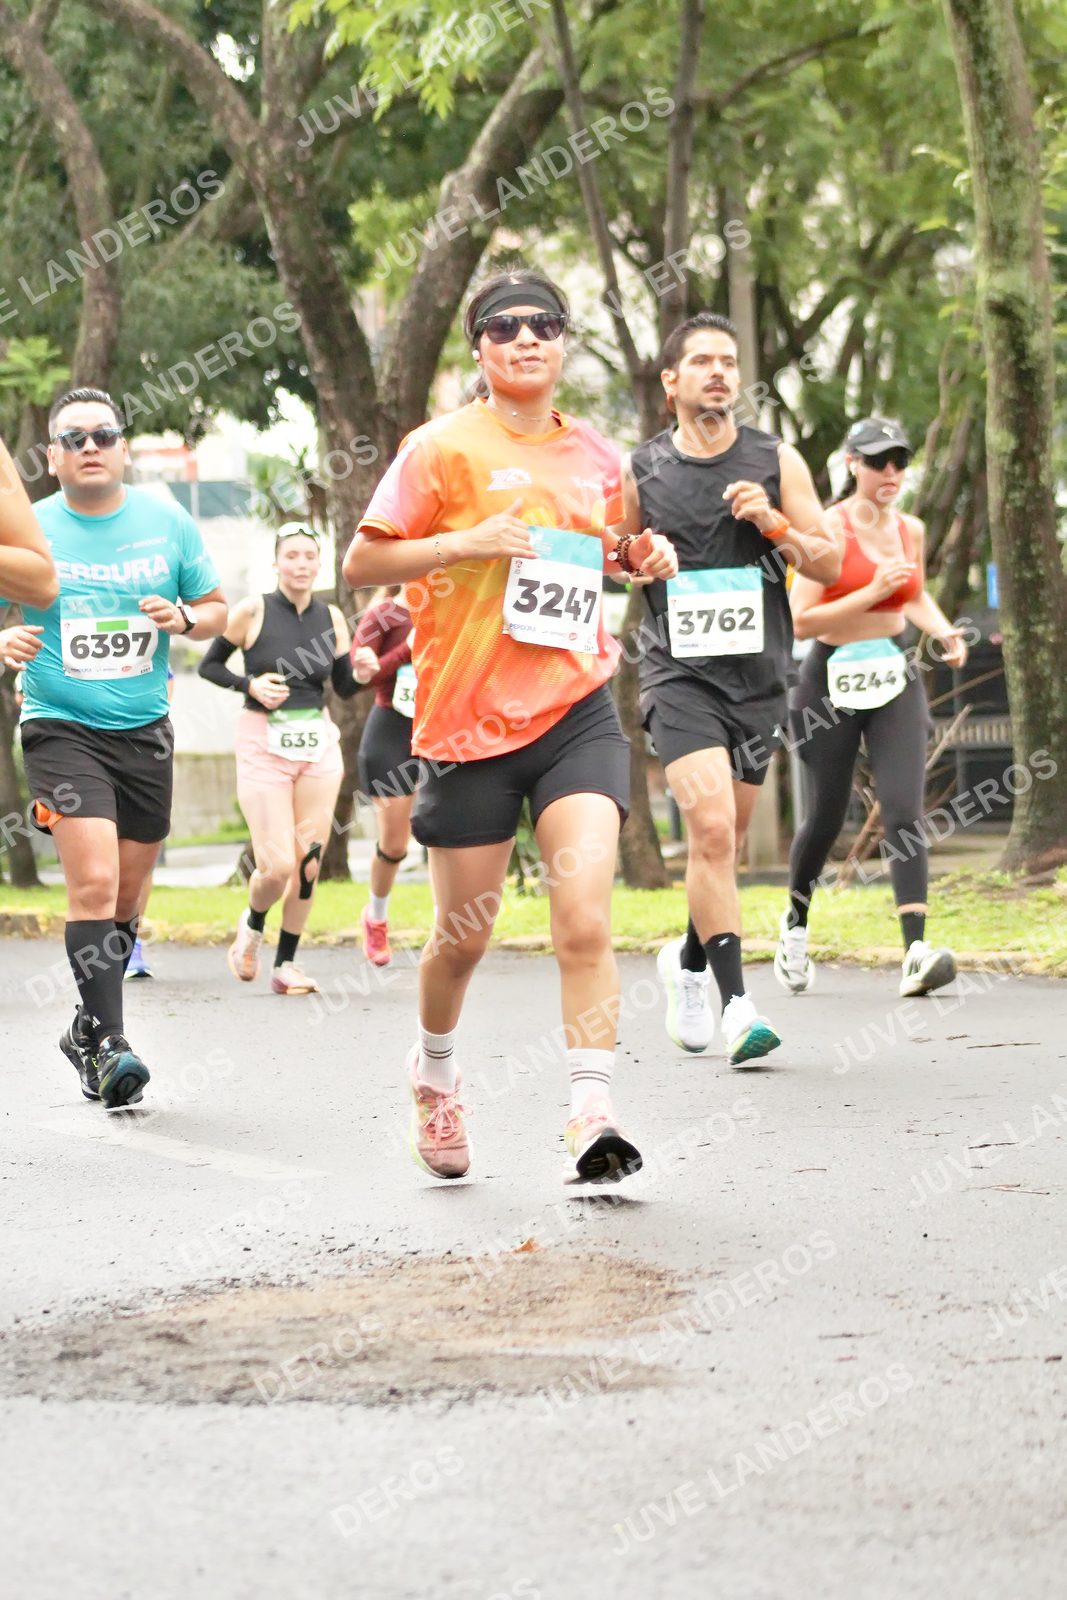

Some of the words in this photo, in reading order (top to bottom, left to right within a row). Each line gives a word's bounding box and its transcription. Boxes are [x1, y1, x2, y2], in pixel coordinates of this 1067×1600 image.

[54, 554, 169, 581] ERDURA
[512, 577, 597, 624] 3247
[676, 606, 756, 636] 3762
[69, 631, 152, 660] 6397
[835, 670, 897, 693] 6244
[280, 732, 319, 748] 635
